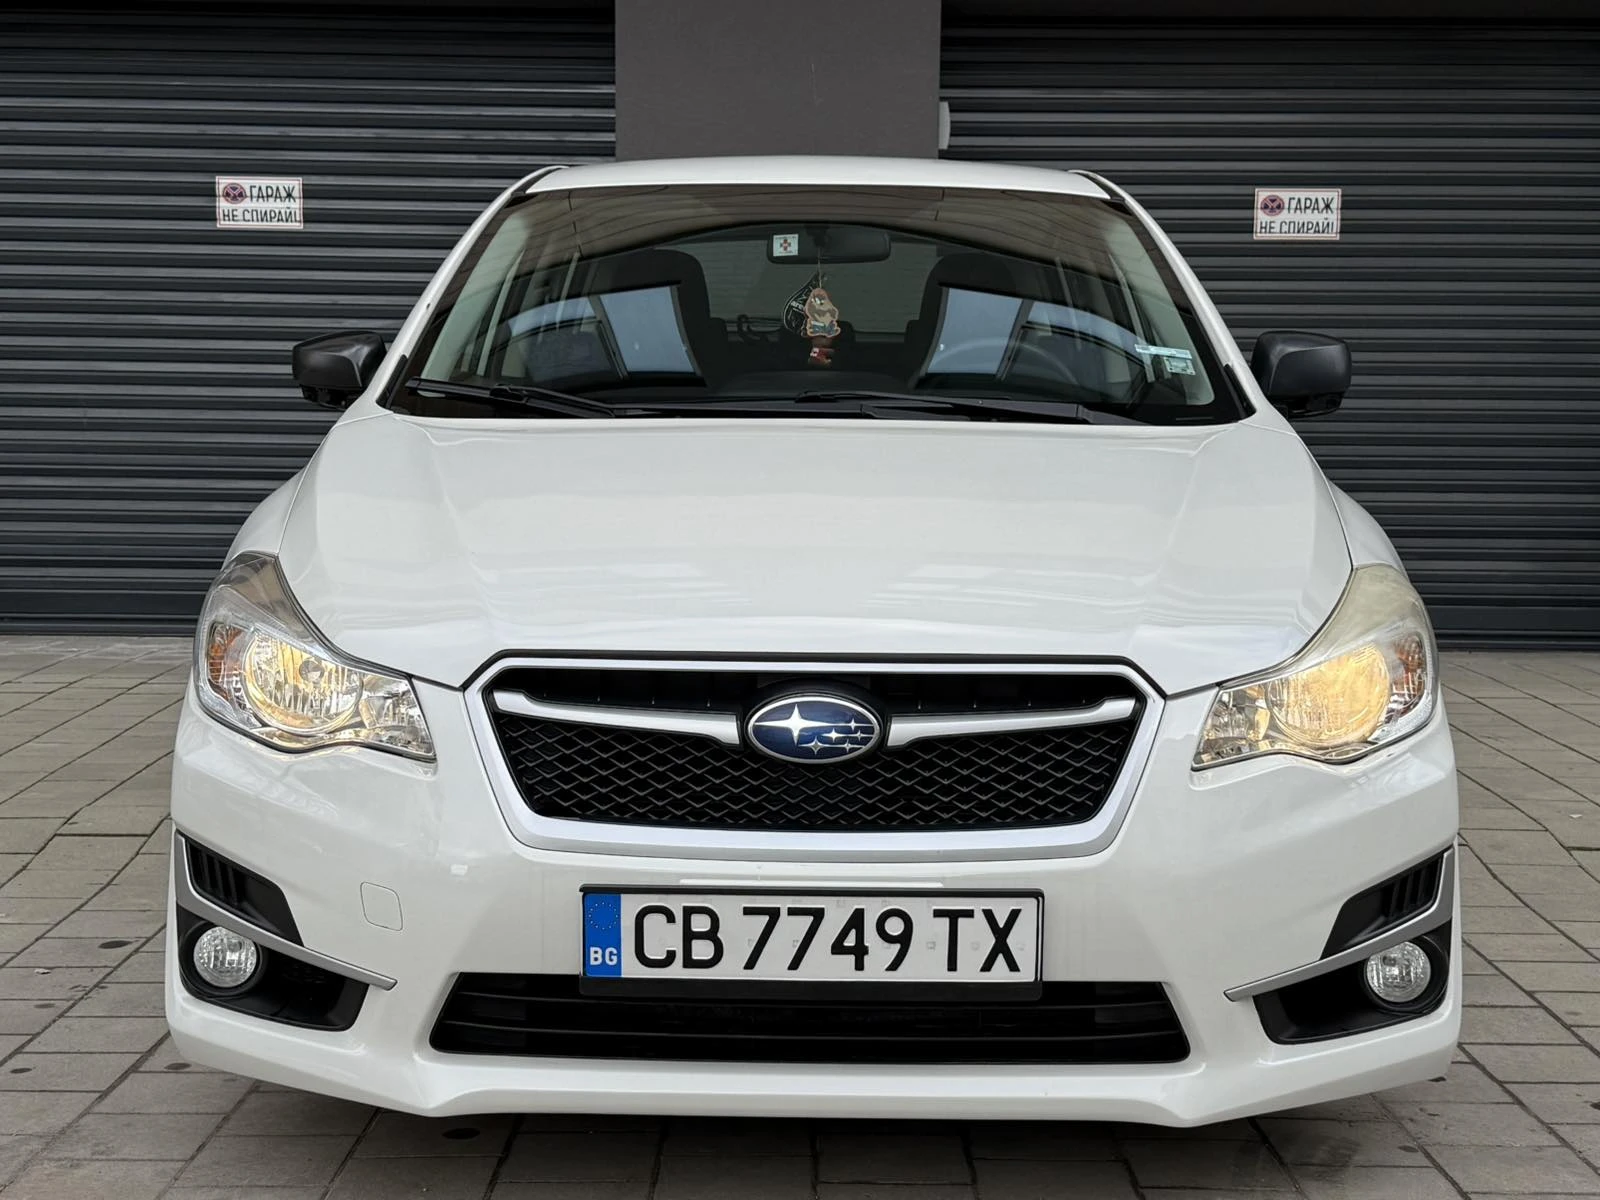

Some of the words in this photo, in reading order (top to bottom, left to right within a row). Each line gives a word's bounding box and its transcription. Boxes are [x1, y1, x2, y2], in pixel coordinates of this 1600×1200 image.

[249, 184, 296, 203] ГАРАЖ
[1287, 196, 1334, 214] ГАРАЖ
[222, 208, 239, 223] НЕ
[242, 207, 298, 223] СПИРАЙ!
[1259, 220, 1276, 234] НЕ
[1279, 217, 1335, 234] СПИРАЙ!
[634, 904, 724, 969] CB
[742, 906, 914, 971] 7749
[932, 908, 1022, 973] TX
[589, 946, 618, 966] BG
